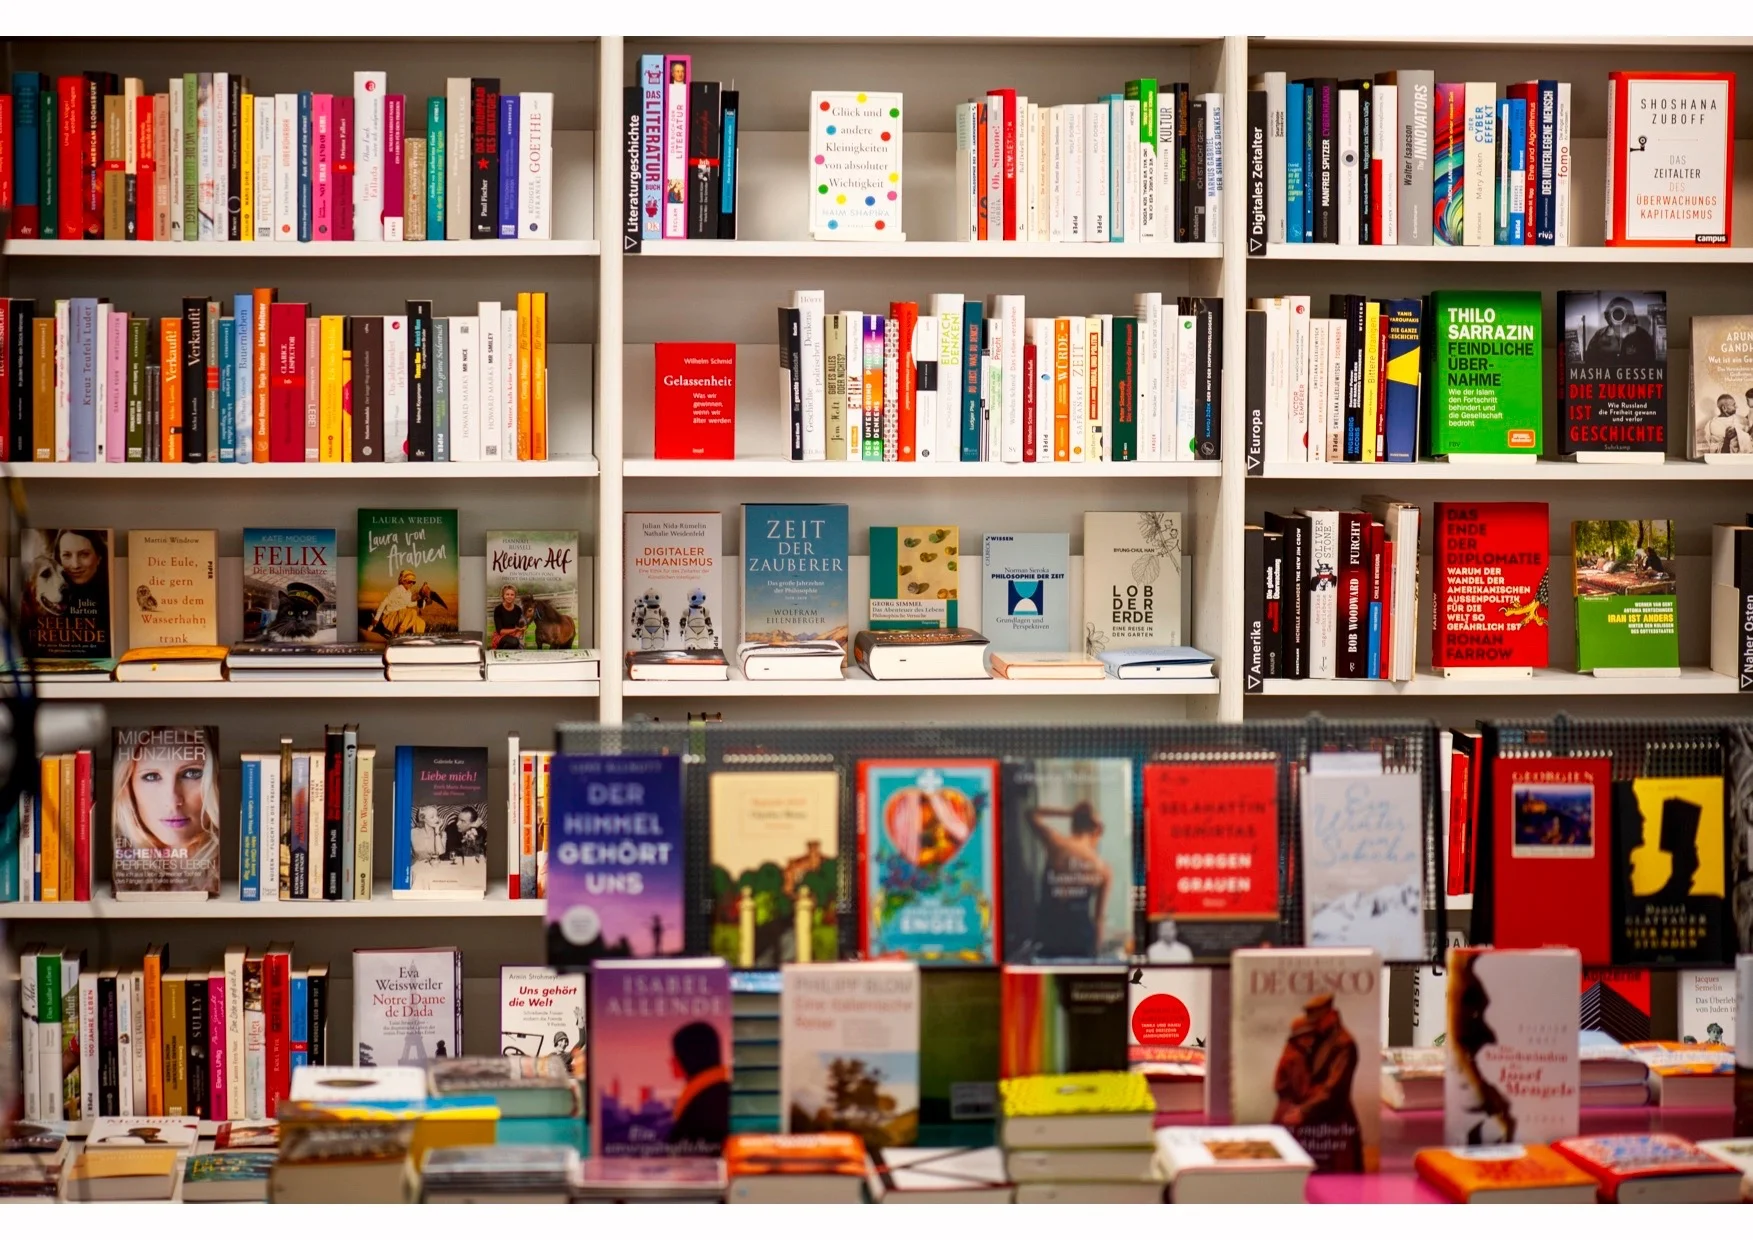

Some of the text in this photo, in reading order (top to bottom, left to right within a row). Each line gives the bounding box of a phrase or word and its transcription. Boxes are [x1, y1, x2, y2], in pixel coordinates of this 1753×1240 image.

[1641, 99, 1717, 109] SHOSHANA
[832, 108, 860, 116] Glück
[475, 87, 485, 153] DAS TRAUMPAAR
[486, 93, 496, 153] DES DIKTATORS
[1475, 107, 1483, 142] CYBER
[1485, 105, 1493, 143] EFFEKT
[1652, 114, 1705, 124] ZUBOFF
[841, 126, 872, 134] andere
[530, 114, 540, 173] GOETHE
[826, 143, 887, 154] Kleinigkeiten
[1404, 126, 1412, 186] Walter Isaacson
[845, 161, 887, 170] absoluter
[627, 115, 641, 232] Literaturgeschichte
[1655, 169, 1700, 178] ZEITALTER
[829, 179, 883, 190] Wichtigkeit
[1641, 210, 1712, 219] KAPITALISMUS
[188, 308, 201, 366] Verkauft!
[239, 310, 247, 369] Bauernleben
[83, 307, 91, 405] Kreuz Teufels Luder
[166, 331, 177, 382] Verkauft!
[436, 325, 445, 393] Das grüne Seidentuch
[664, 375, 732, 386] Gelassenheit
[1251, 410, 1262, 454] Europa
[373, 516, 404, 524] LAURA
[254, 546, 327, 566] FELIX
[636, 558, 713, 566] HUMANISMUS
[148, 557, 198, 569] Die Eule,
[149, 576, 193, 588] die gern
[182, 596, 203, 605] dem
[1447, 603, 1464, 612] FÜR
[141, 614, 206, 624] Wasserhahn
[160, 633, 188, 643] trank
[1251, 621, 1261, 673] Amerika
[421, 771, 476, 781] Liebe mich!
[1177, 854, 1251, 868] MORGEN
[1178, 877, 1250, 892] GRAUEN
[519, 986, 577, 996] Uns gehört
[623, 975, 708, 995] ISABEL
[795, 976, 860, 994] PHILIPP
[193, 996, 202, 1037] SULLY
